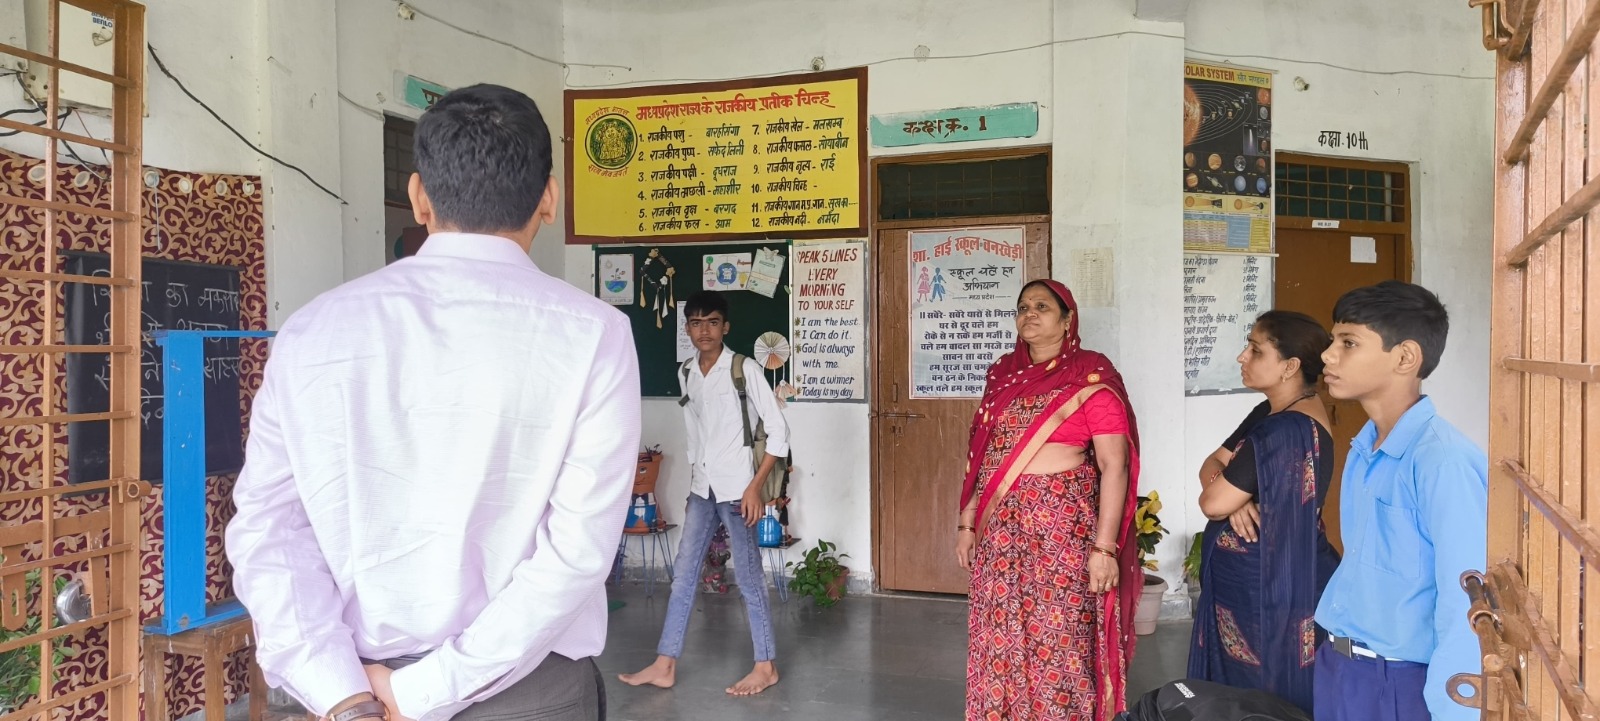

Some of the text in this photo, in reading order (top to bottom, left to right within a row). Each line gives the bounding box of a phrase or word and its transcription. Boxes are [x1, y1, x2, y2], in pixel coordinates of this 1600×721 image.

[1184, 65, 1205, 78] OLAR
[1206, 68, 1235, 82] SYSTEM
[715, 93, 757, 114] राजकीय
[758, 92, 794, 111] प्रतीक
[795, 88, 835, 108] चिन्ह
[752, 124, 760, 135] 7.
[766, 117, 790, 135] राजकीय
[790, 116, 804, 132] खेल
[979, 115, 987, 131] 1
[648, 125, 672, 143] राजकीय
[673, 130, 685, 143] पशु
[753, 131, 849, 155] 8. राजकीय फसल सोयाबीन
[650, 143, 680, 160] राजकीय
[767, 156, 794, 174] राजकीय
[796, 160, 811, 175] नृत्य
[821, 152, 837, 171] राई
[638, 163, 737, 182] 3. राजकीय पक्षी दूधराज
[638, 190, 647, 201] 4.
[651, 182, 680, 200] राजकीय
[751, 176, 808, 193] 10. राजकीय चिन्ह
[638, 201, 737, 219] 5. राजकीय वृक्ष बरगद
[751, 202, 762, 213] 11.
[764, 195, 788, 212] राजकीय
[638, 217, 732, 232] 6. राजकीय फल आम
[751, 209, 840, 227] 12. राजकीय नदी नर्मदा
[821, 249, 829, 263] 5
[829, 248, 858, 263] LINES
[912, 250, 930, 263] शा.
[934, 236, 952, 258] हाई
[955, 236, 980, 256] स्कूल
[808, 268, 838, 281] EVERY
[948, 267, 975, 281] स्कूल
[962, 277, 1000, 291] अभियान
[165, 282, 189, 308] का
[798, 299, 855, 311] TO YOUR SELF
[985, 308, 992, 318] से
[801, 317, 806, 326] I
[807, 319, 821, 327] am
[824, 317, 838, 326] the
[939, 321, 949, 329] घर
[951, 320, 958, 329] से
[960, 320, 970, 331] दूर
[987, 320, 999, 329] हम
[802, 330, 807, 339] I
[810, 330, 826, 340] Can
[828, 330, 839, 340] do
[940, 330, 947, 340] से
[948, 332, 955, 340] न
[972, 331, 984, 340] हम
[1005, 330, 1012, 339] से
[801, 343, 856, 357] God is always
[972, 342, 982, 350] सा
[984, 341, 1002, 350] गरजे
[1004, 342, 1016, 350] हम
[802, 359, 821, 368] with
[942, 353, 963, 361] सावन
[965, 353, 975, 361] सा
[929, 363, 940, 371] हम
[942, 364, 960, 373] सूरज
[962, 363, 972, 371] सा
[802, 374, 807, 384] I
[820, 376, 826, 384] a
[826, 375, 855, 385] winner
[958, 372, 965, 381] के
[802, 386, 854, 399] Today is my day
[916, 384, 933, 394] स्कूल
[951, 384, 962, 392] हम
[965, 384, 983, 394] स्कूल
